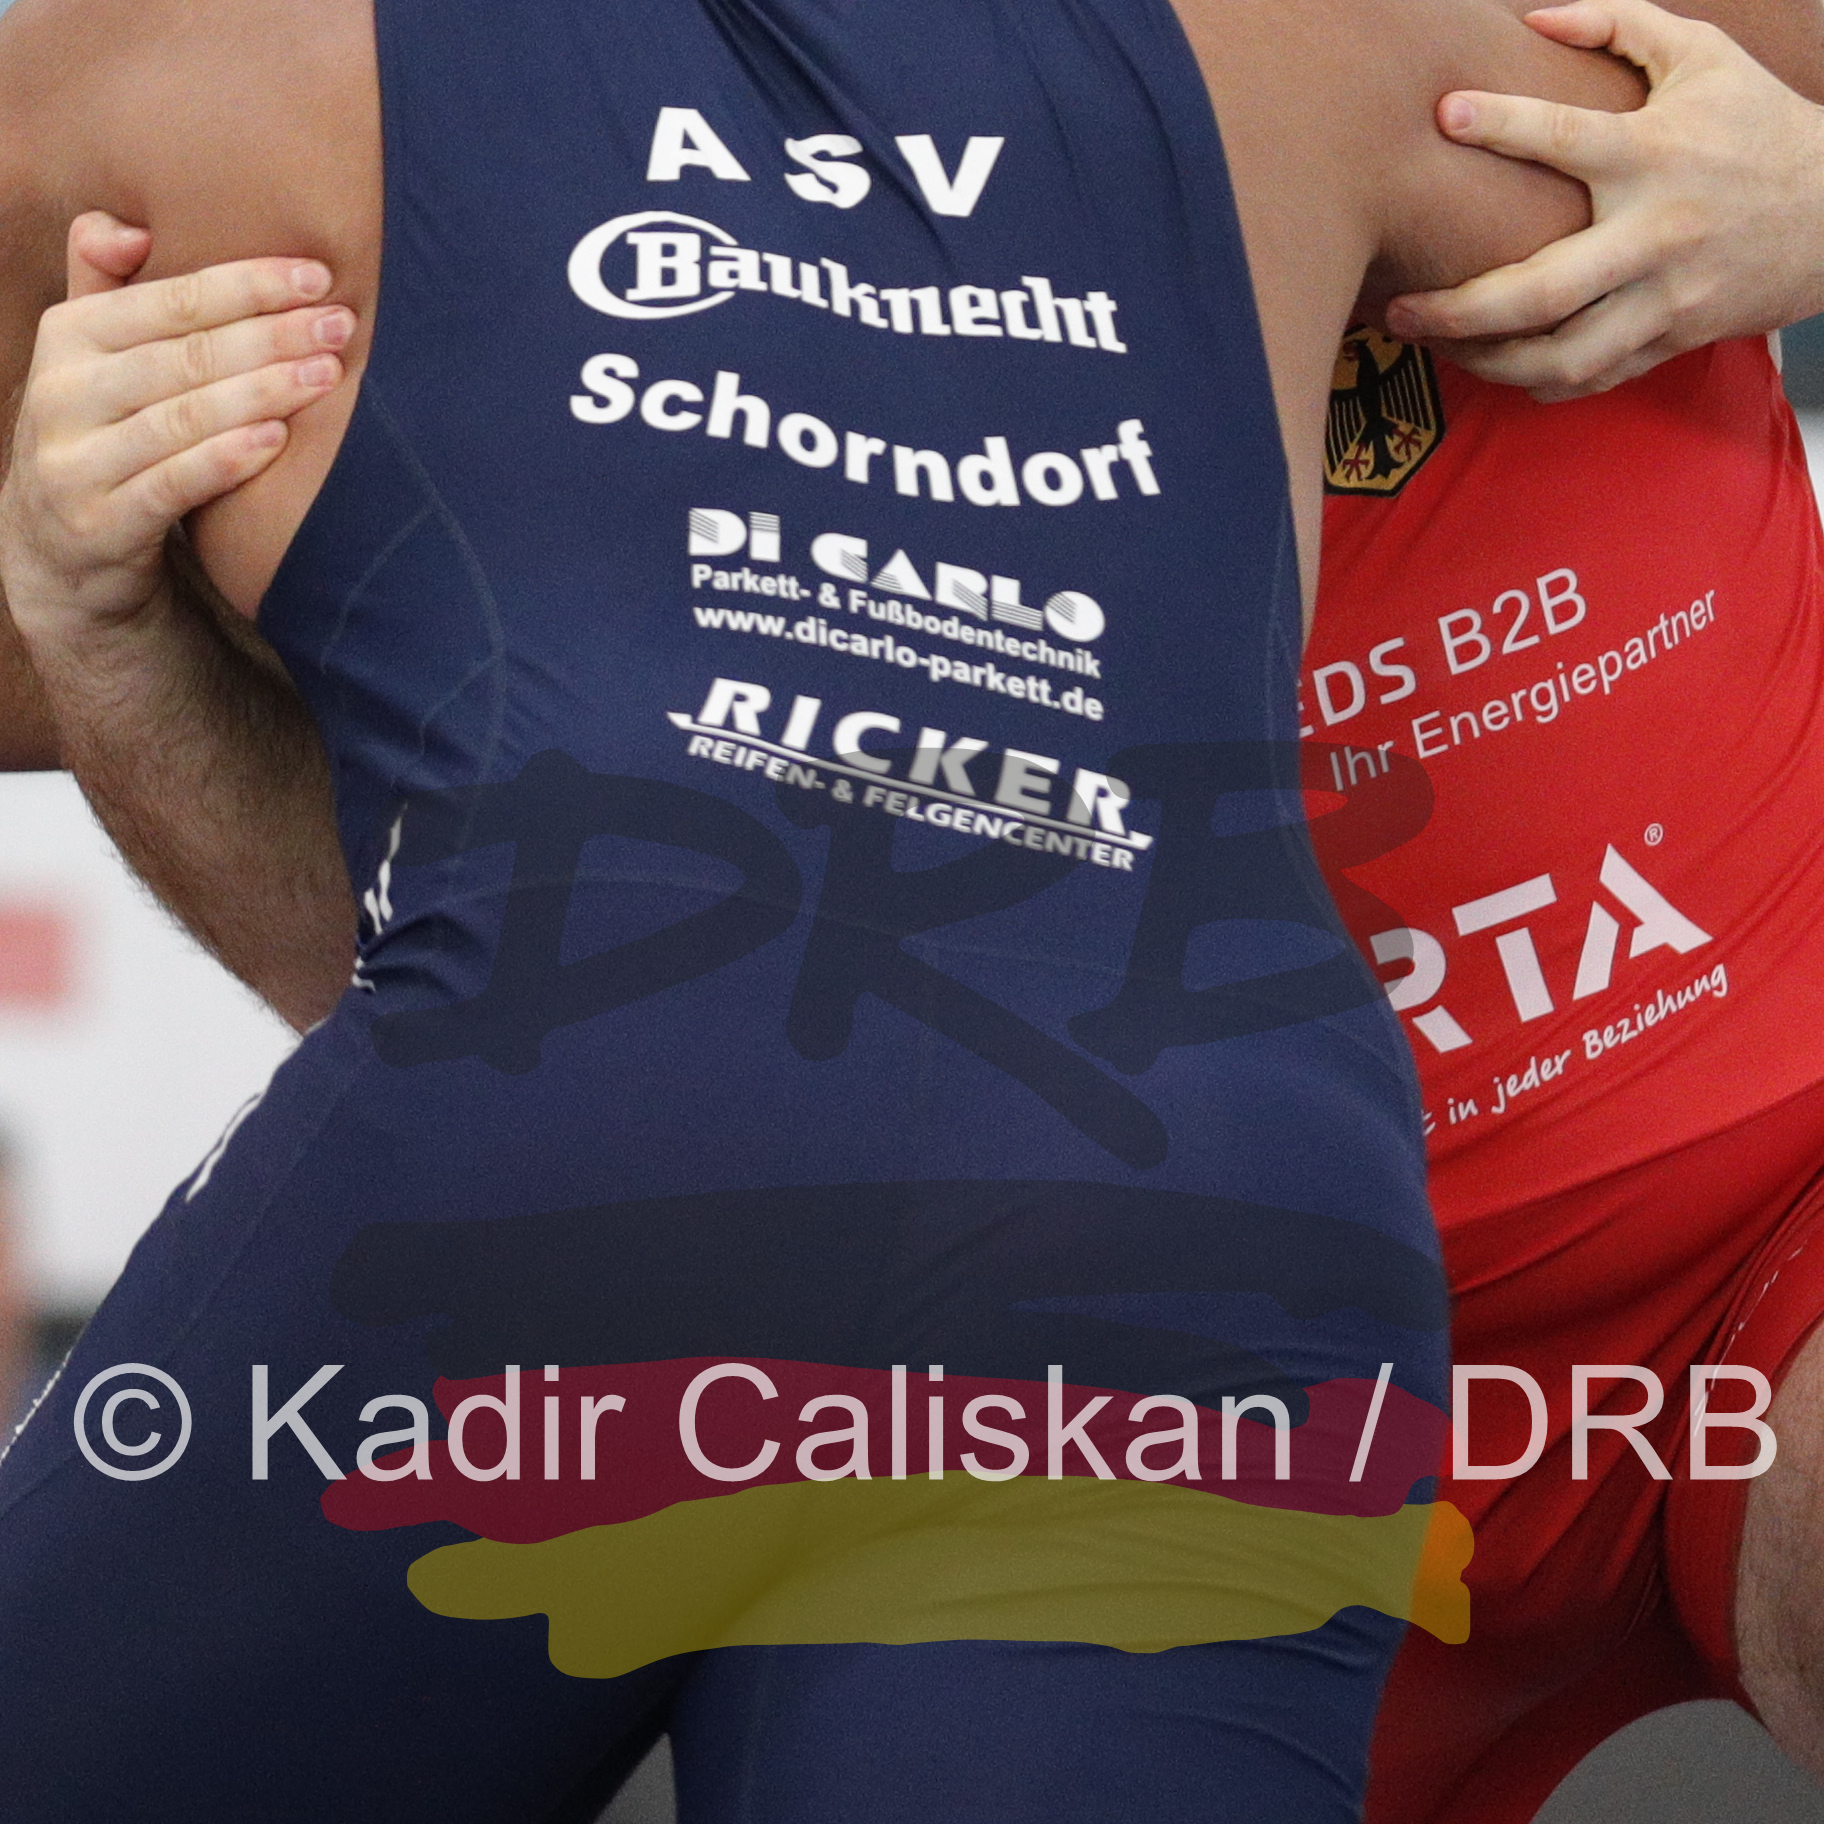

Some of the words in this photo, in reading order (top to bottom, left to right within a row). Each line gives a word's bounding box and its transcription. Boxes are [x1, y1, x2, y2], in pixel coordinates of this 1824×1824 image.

[646, 106, 1005, 218] ASV
[569, 352, 1161, 507] Schorndorf
[688, 507, 781, 562] DI
[810, 532, 1105, 642] CARLO
[690, 564, 811, 601] Parkett-
[818, 582, 842, 610] &
[848, 589, 1103, 679] Fußbodentechnik
[1437, 567, 1588, 675] B2B
[692, 606, 1105, 722] www.dicarlo-parkett.de
[1329, 739, 1395, 792] Ihr
[1411, 589, 1716, 759] Energiepartner
[687, 734, 826, 790] REIFEN-
[832, 778, 855, 804] &
[862, 787, 1134, 873] FELGENCENTER
[696, 677, 1133, 836] RICKER
[1447, 1097, 1479, 1126] in
[1491, 1049, 1572, 1115] jeder
[1581, 962, 1729, 1060] Beziehung
